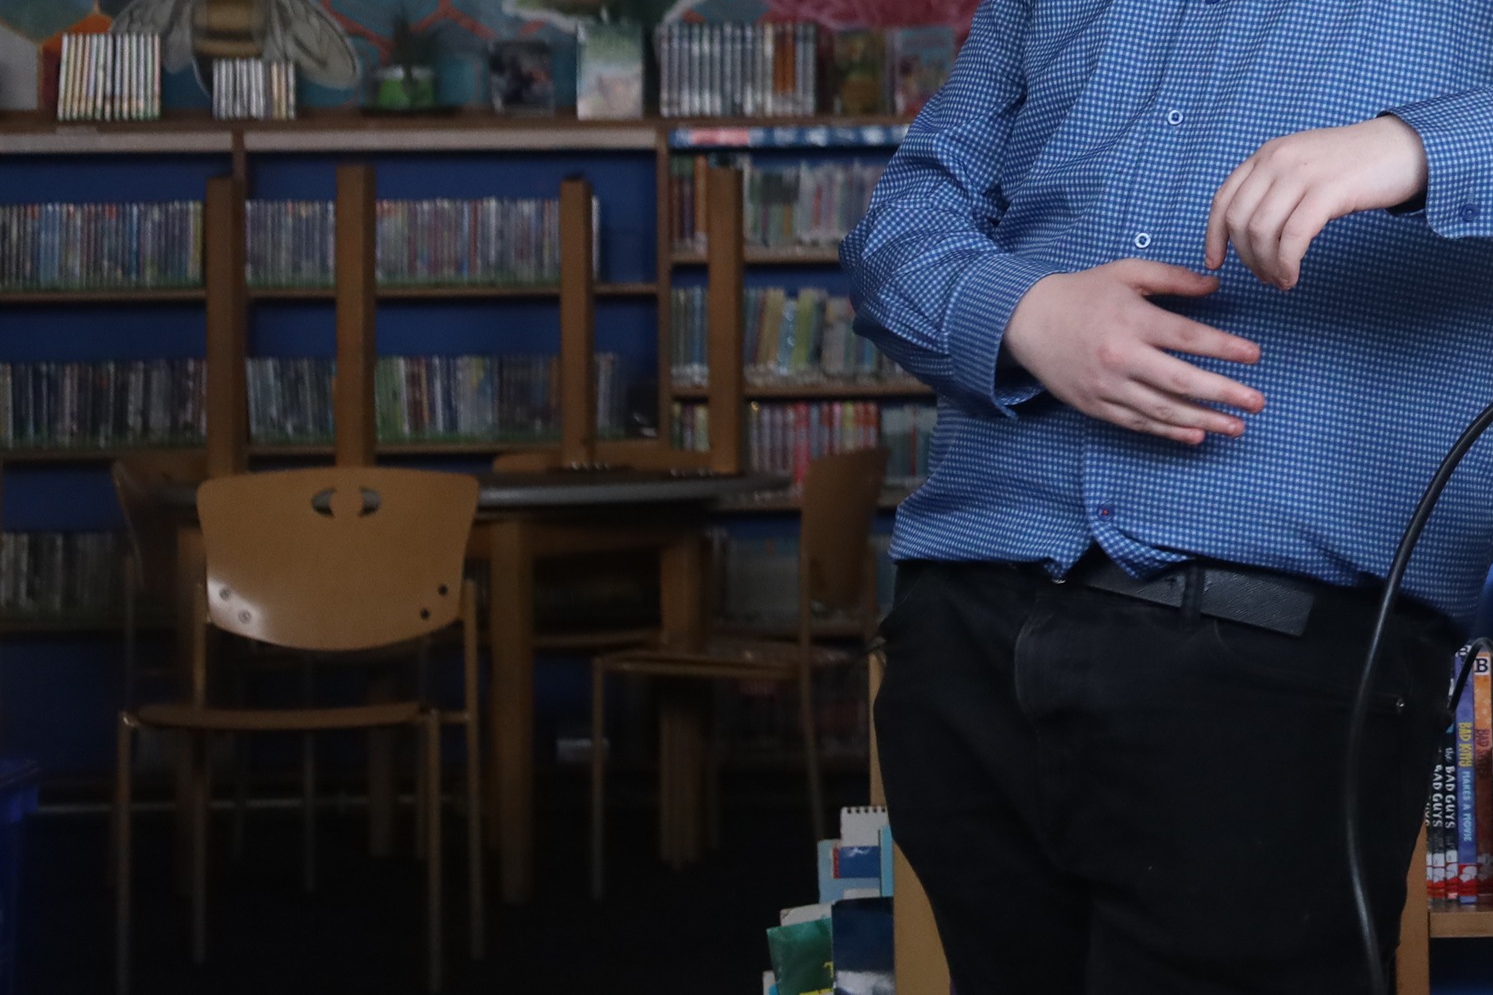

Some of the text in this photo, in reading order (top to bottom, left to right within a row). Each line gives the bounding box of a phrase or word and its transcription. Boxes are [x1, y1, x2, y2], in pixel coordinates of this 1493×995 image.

[1475, 658, 1488, 673] B
[1459, 723, 1472, 741] BAD
[1445, 766, 1455, 791] BAD
[1462, 771, 1471, 800] MAKES
[1433, 794, 1442, 827] GUYS
[1445, 795, 1455, 829] GUYS
[1462, 813, 1472, 841] MOVIE
